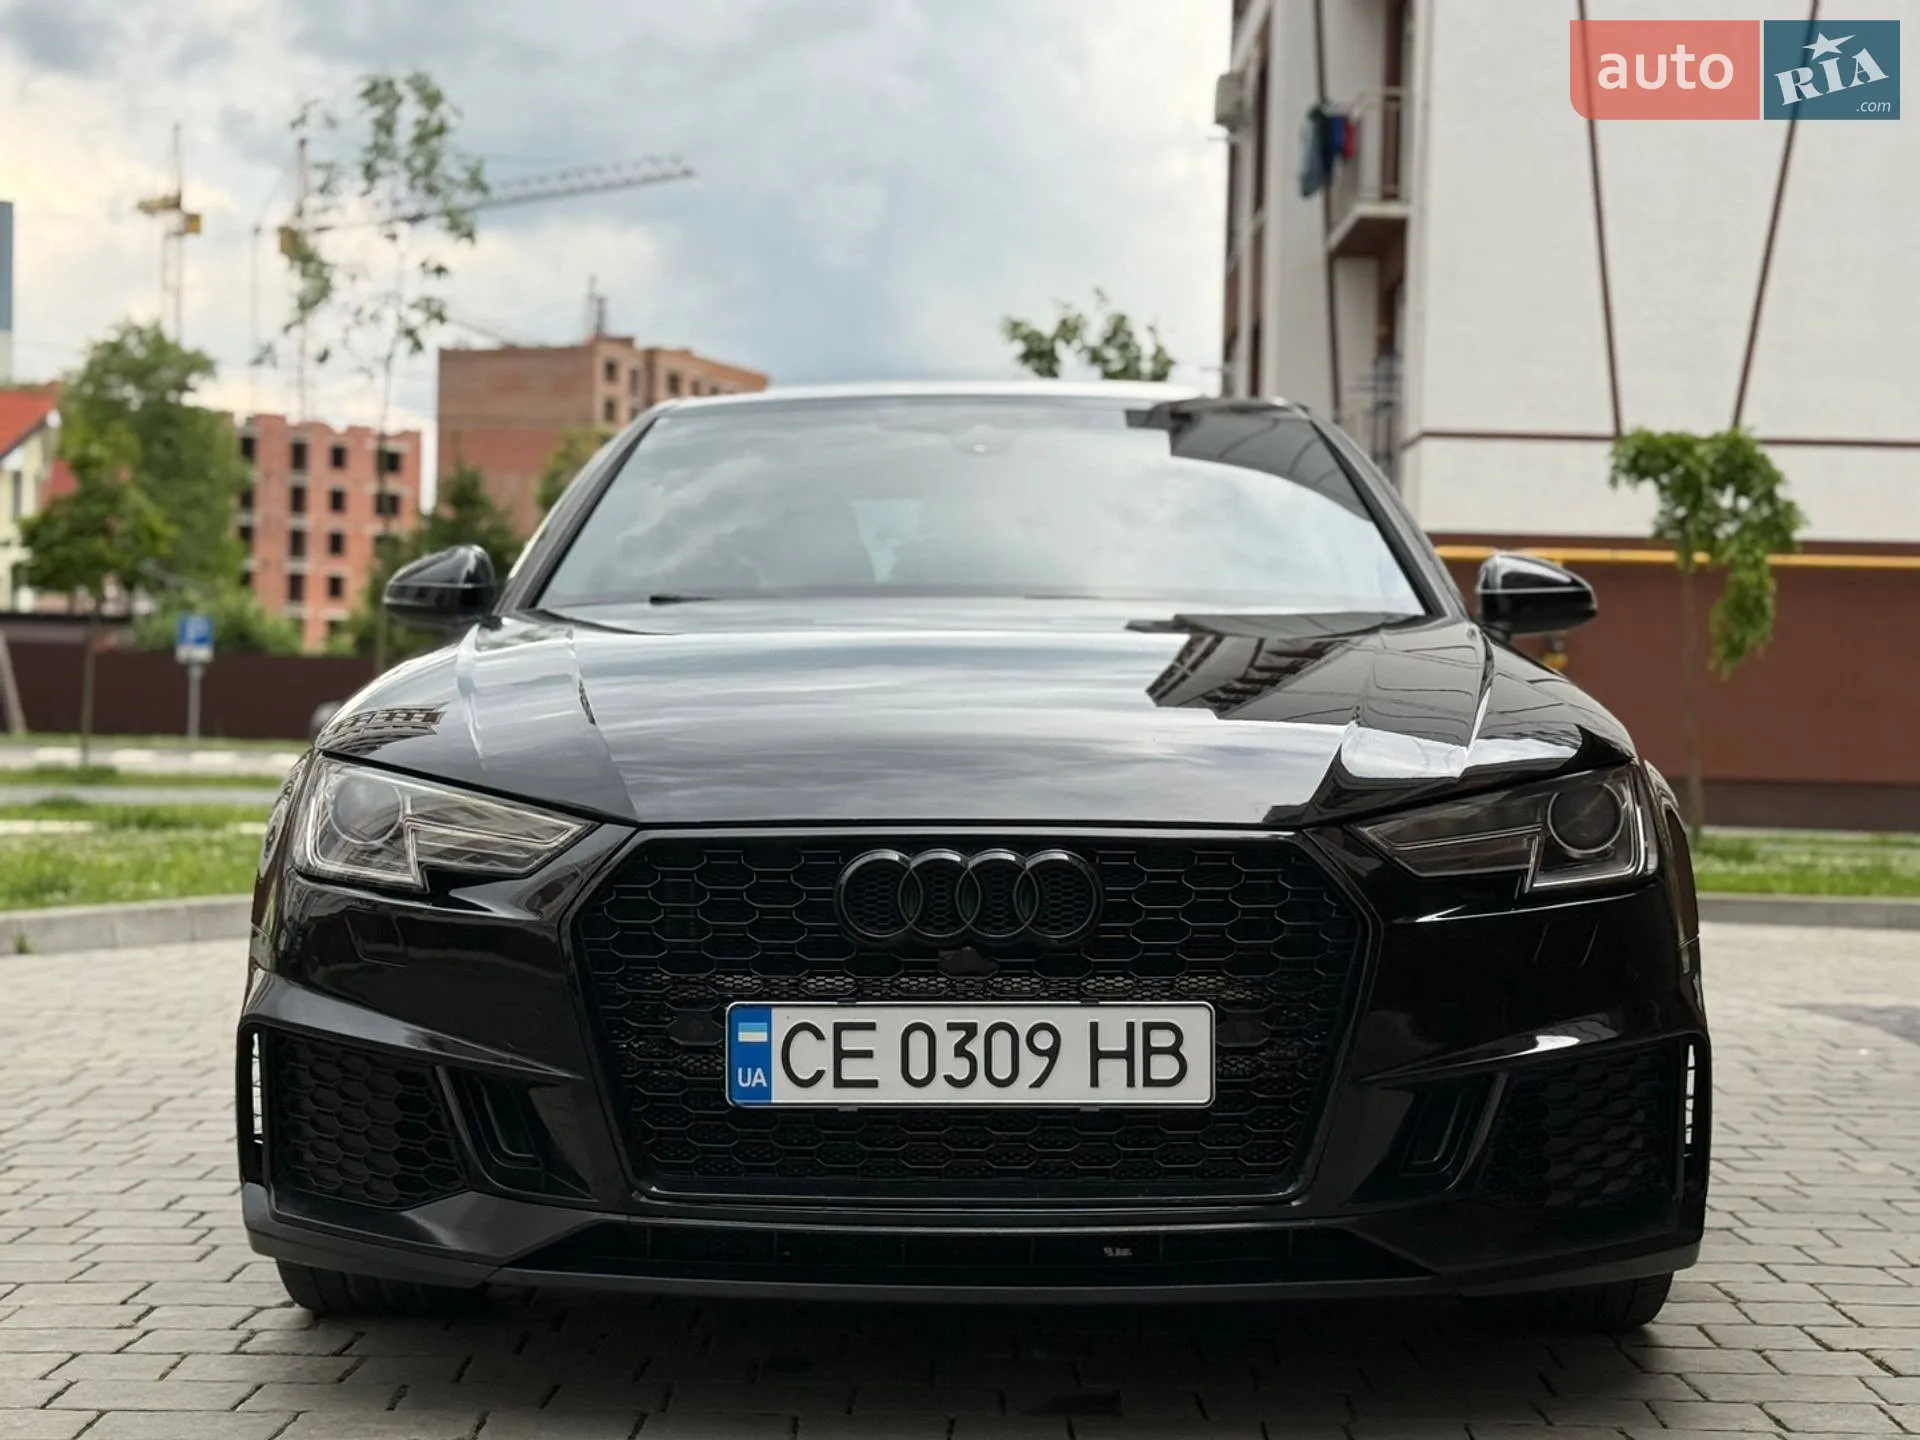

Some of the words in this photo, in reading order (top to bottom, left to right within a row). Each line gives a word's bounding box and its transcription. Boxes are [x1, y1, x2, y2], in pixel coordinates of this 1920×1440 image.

[781, 1021, 880, 1089] CE
[900, 1021, 1062, 1089] 0309
[1089, 1021, 1188, 1088] HB
[738, 1067, 768, 1088] UA
